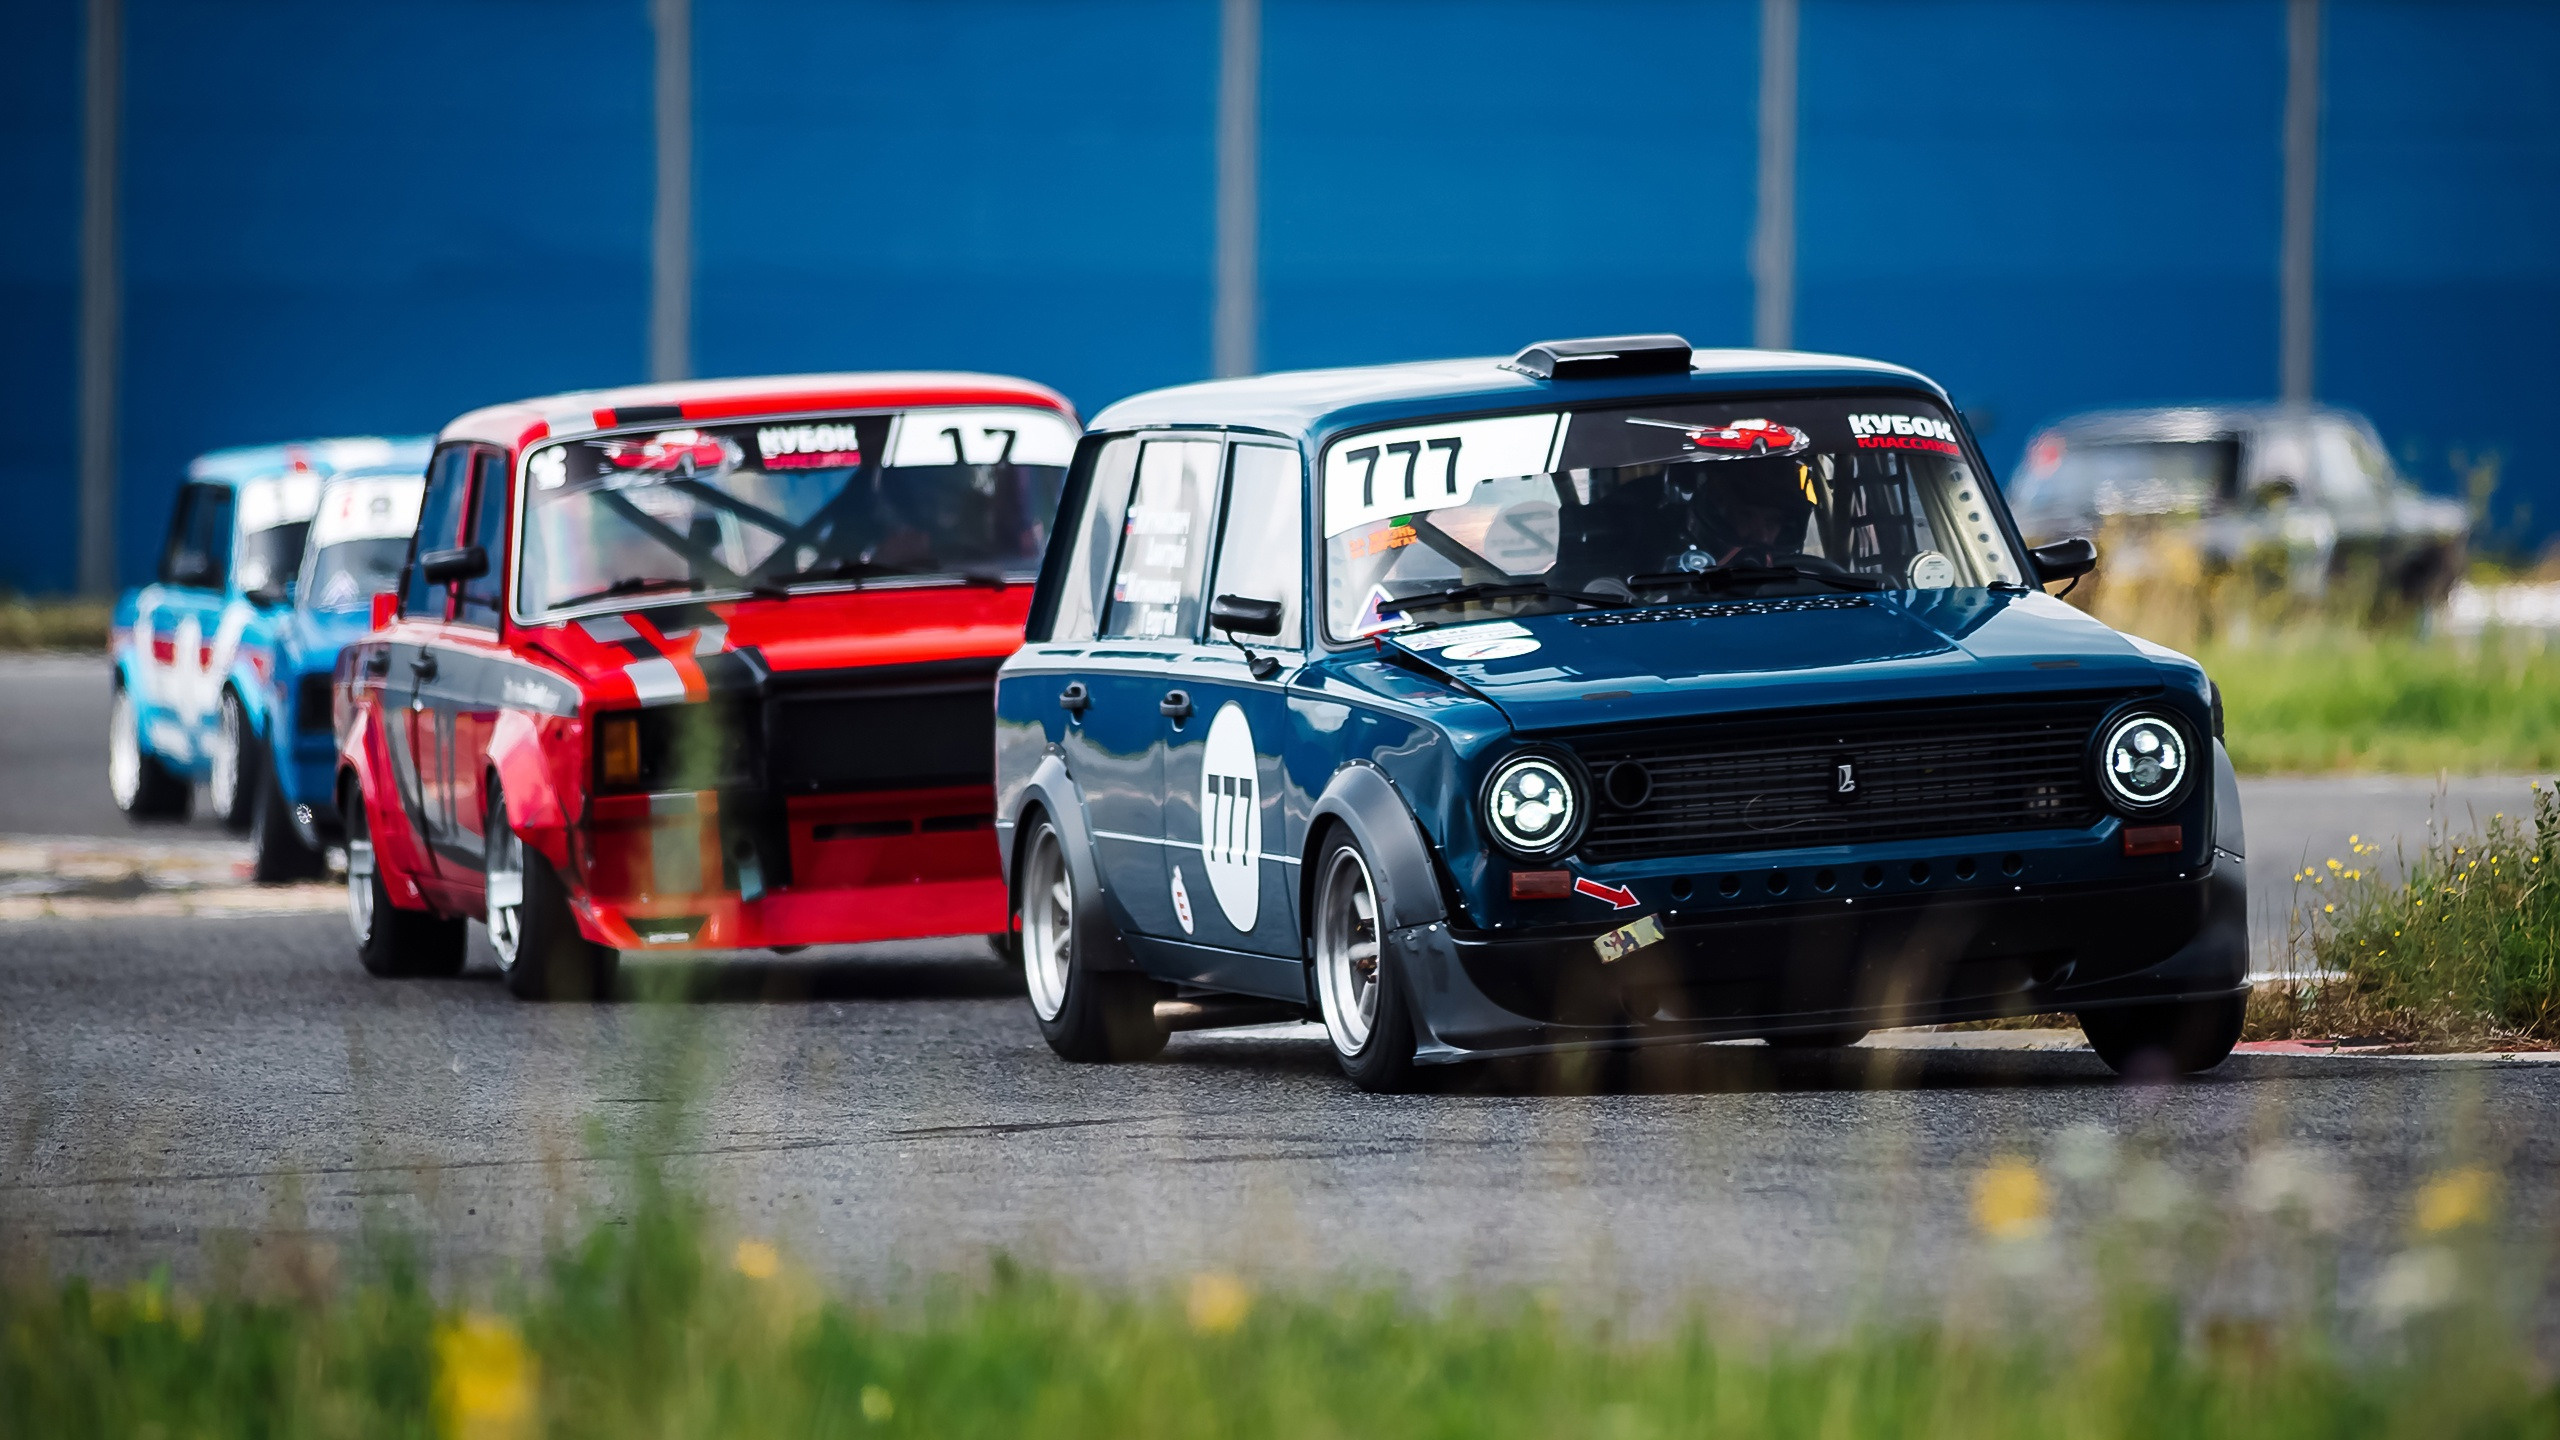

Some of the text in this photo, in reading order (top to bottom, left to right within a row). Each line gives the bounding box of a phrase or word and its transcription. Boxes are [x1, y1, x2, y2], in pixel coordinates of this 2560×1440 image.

[941, 427, 1016, 465] 17
[1848, 414, 1957, 443] КУБОК
[1345, 436, 1462, 508] 777
[1208, 774, 1253, 867] 777
